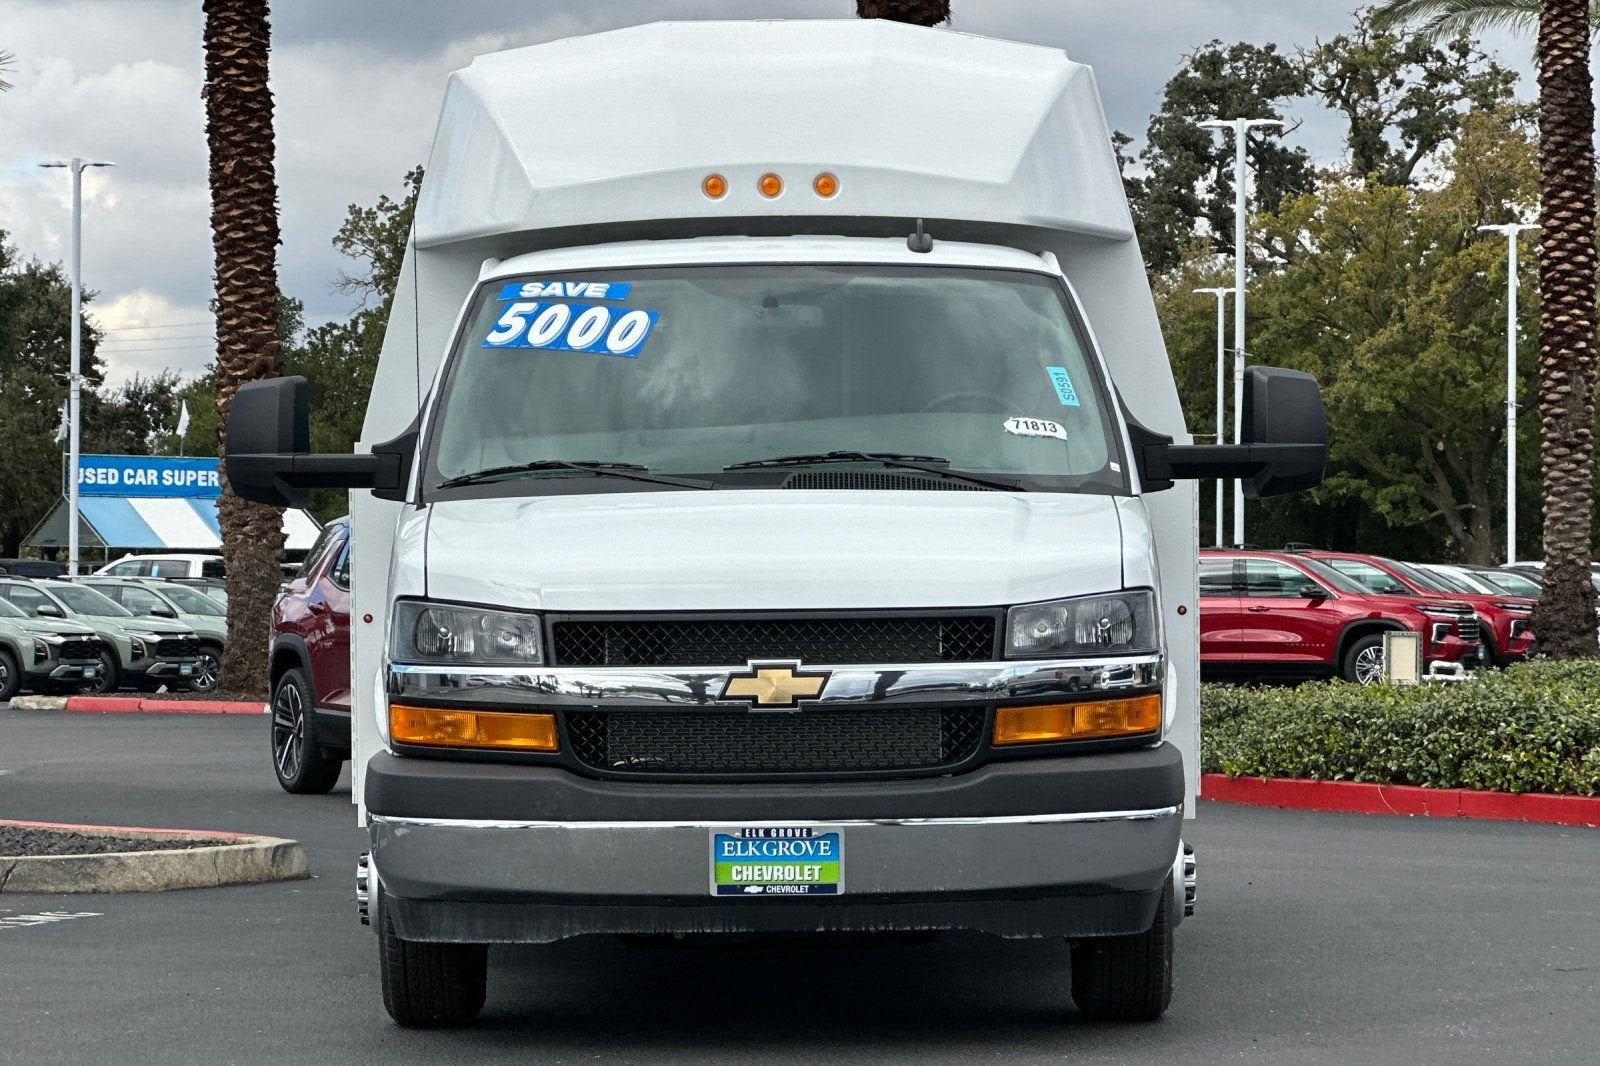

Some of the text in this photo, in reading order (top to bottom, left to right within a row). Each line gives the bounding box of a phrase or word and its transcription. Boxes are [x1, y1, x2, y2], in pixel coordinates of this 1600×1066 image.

[519, 282, 610, 297] SAVE
[486, 302, 650, 353] 5000
[1052, 371, 1075, 401] S0591
[1012, 419, 1058, 433] 71813
[123, 468, 158, 486] CAR
[162, 469, 219, 487] SUPER
[745, 828, 808, 838] ELK GROVE
[731, 865, 822, 881] CHEVROLET
[765, 884, 810, 894] CHEVROLET
